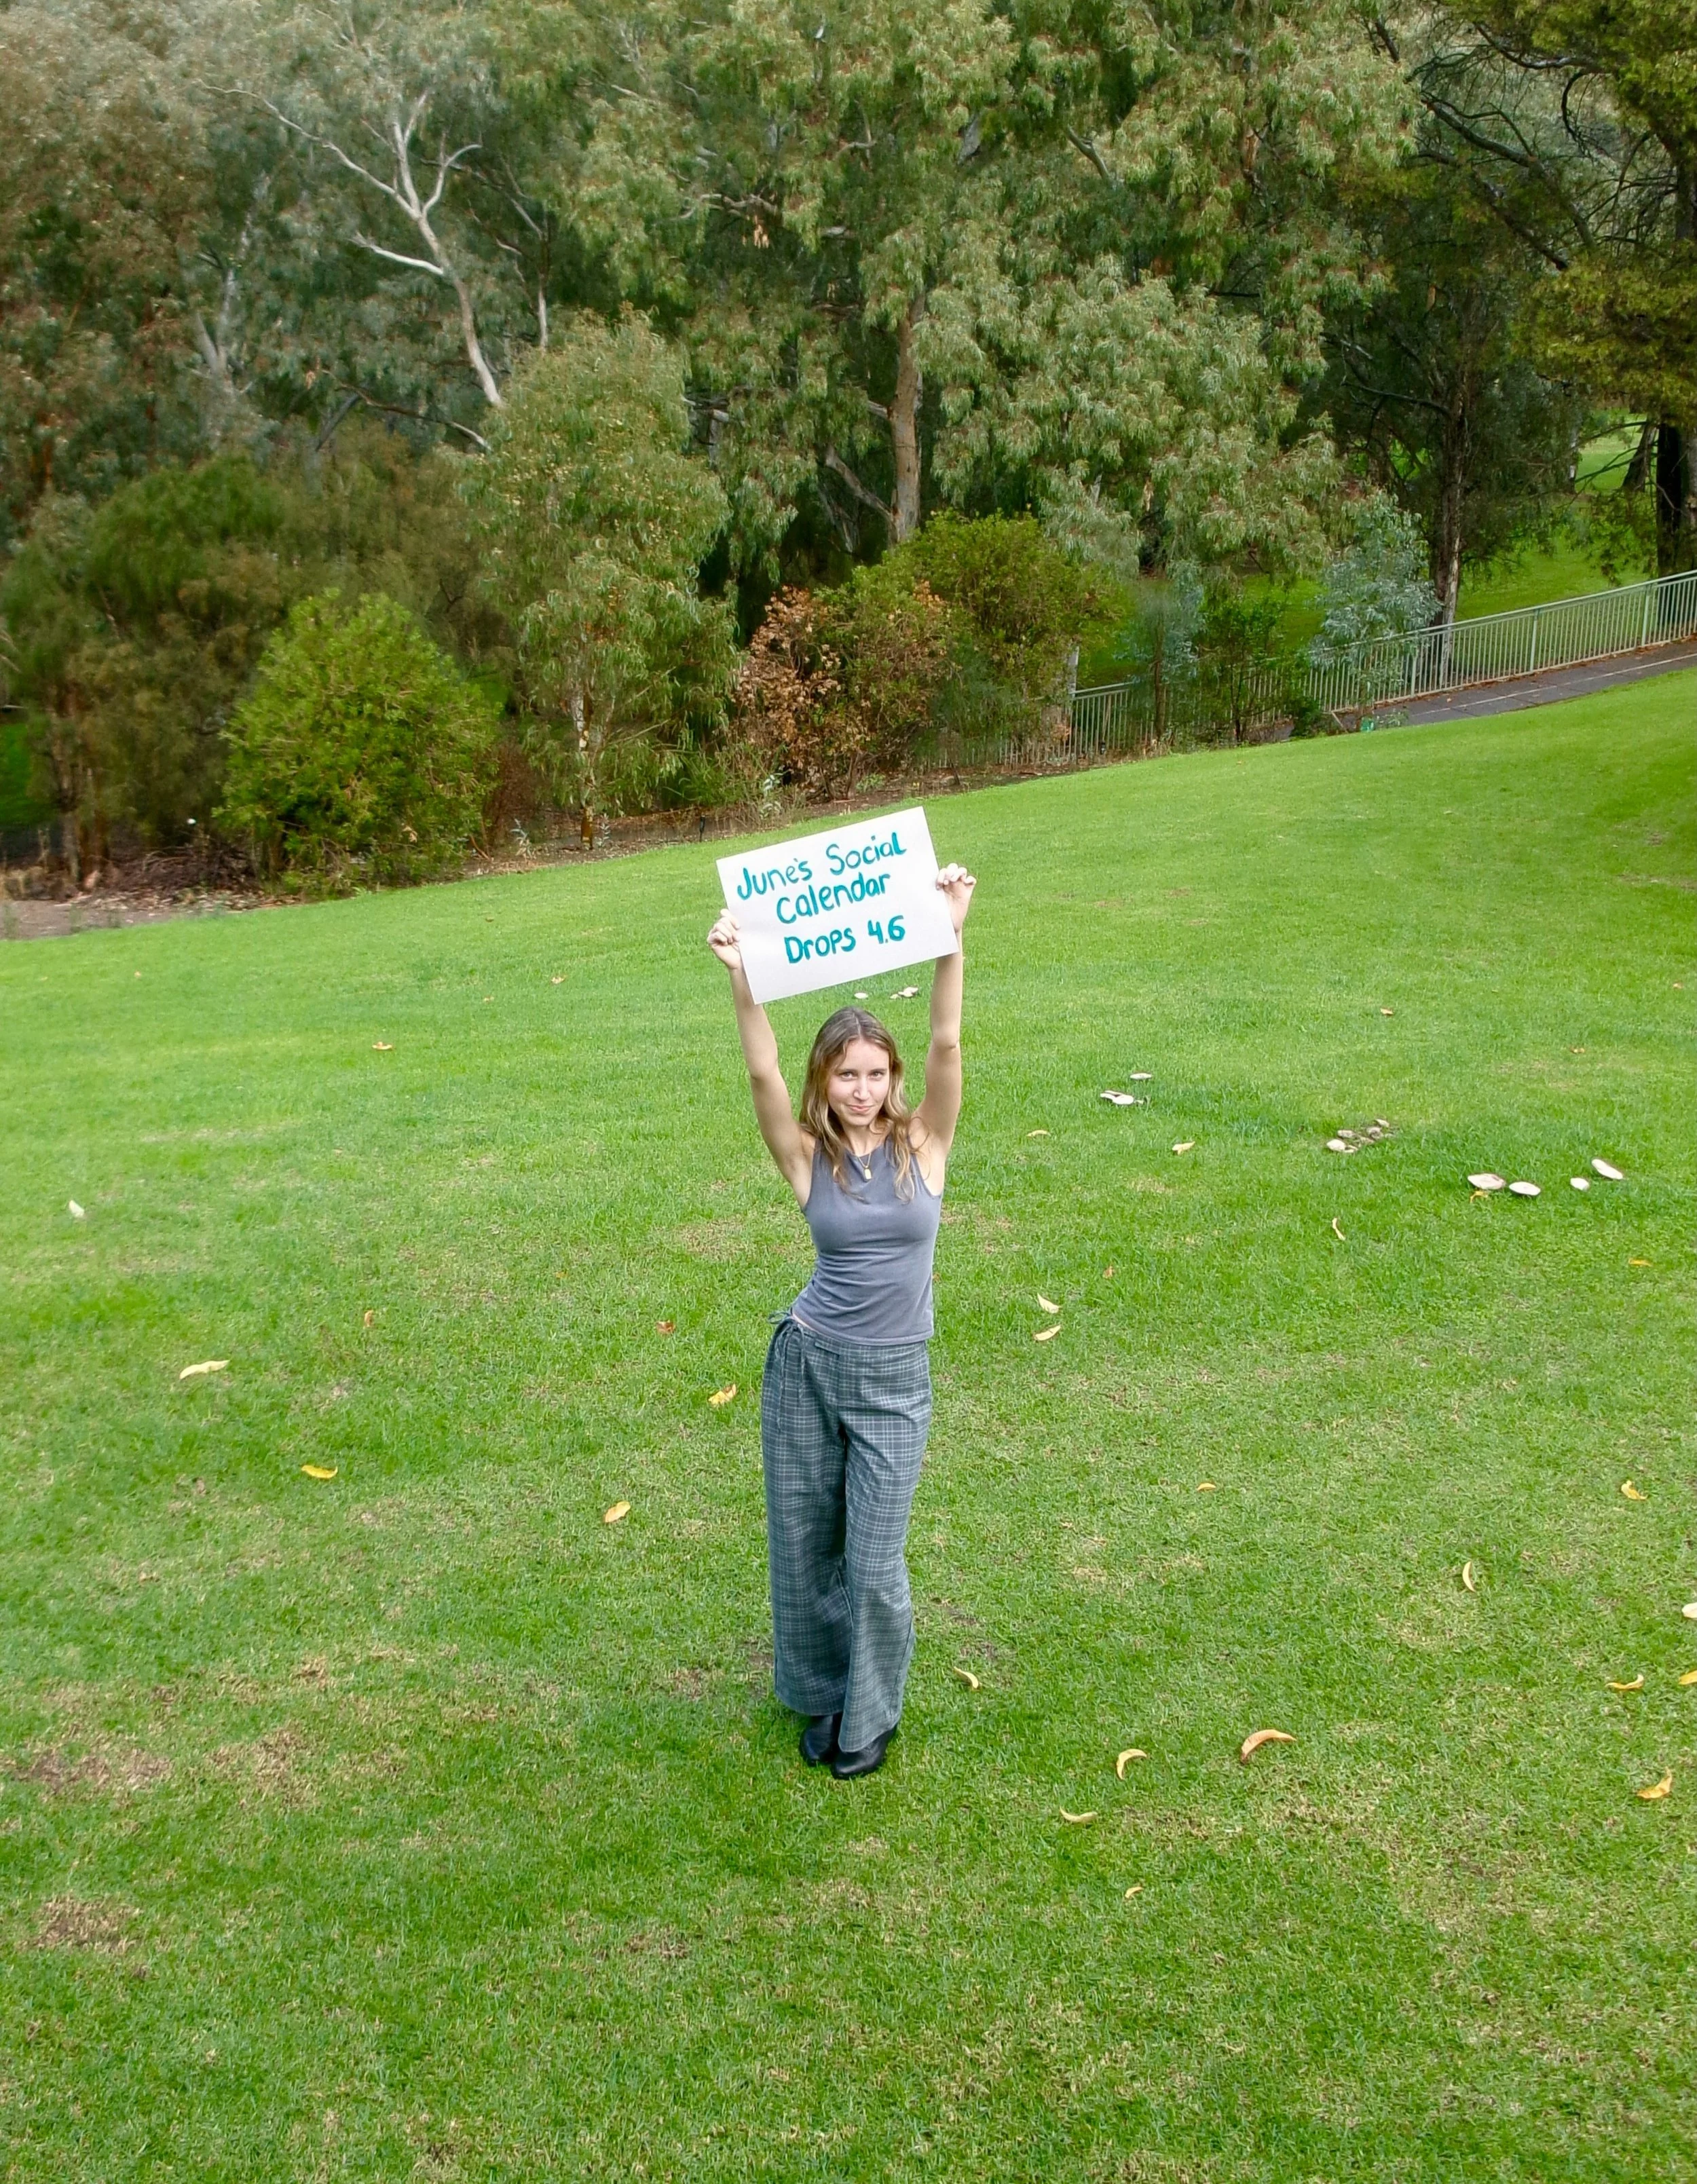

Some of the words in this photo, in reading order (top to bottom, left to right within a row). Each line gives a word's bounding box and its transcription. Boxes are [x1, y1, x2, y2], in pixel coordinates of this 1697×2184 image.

[736, 858, 813, 901] June's
[825, 831, 907, 876] Social
[776, 871, 891, 924] Calendar
[868, 915, 906, 944] 4.6
